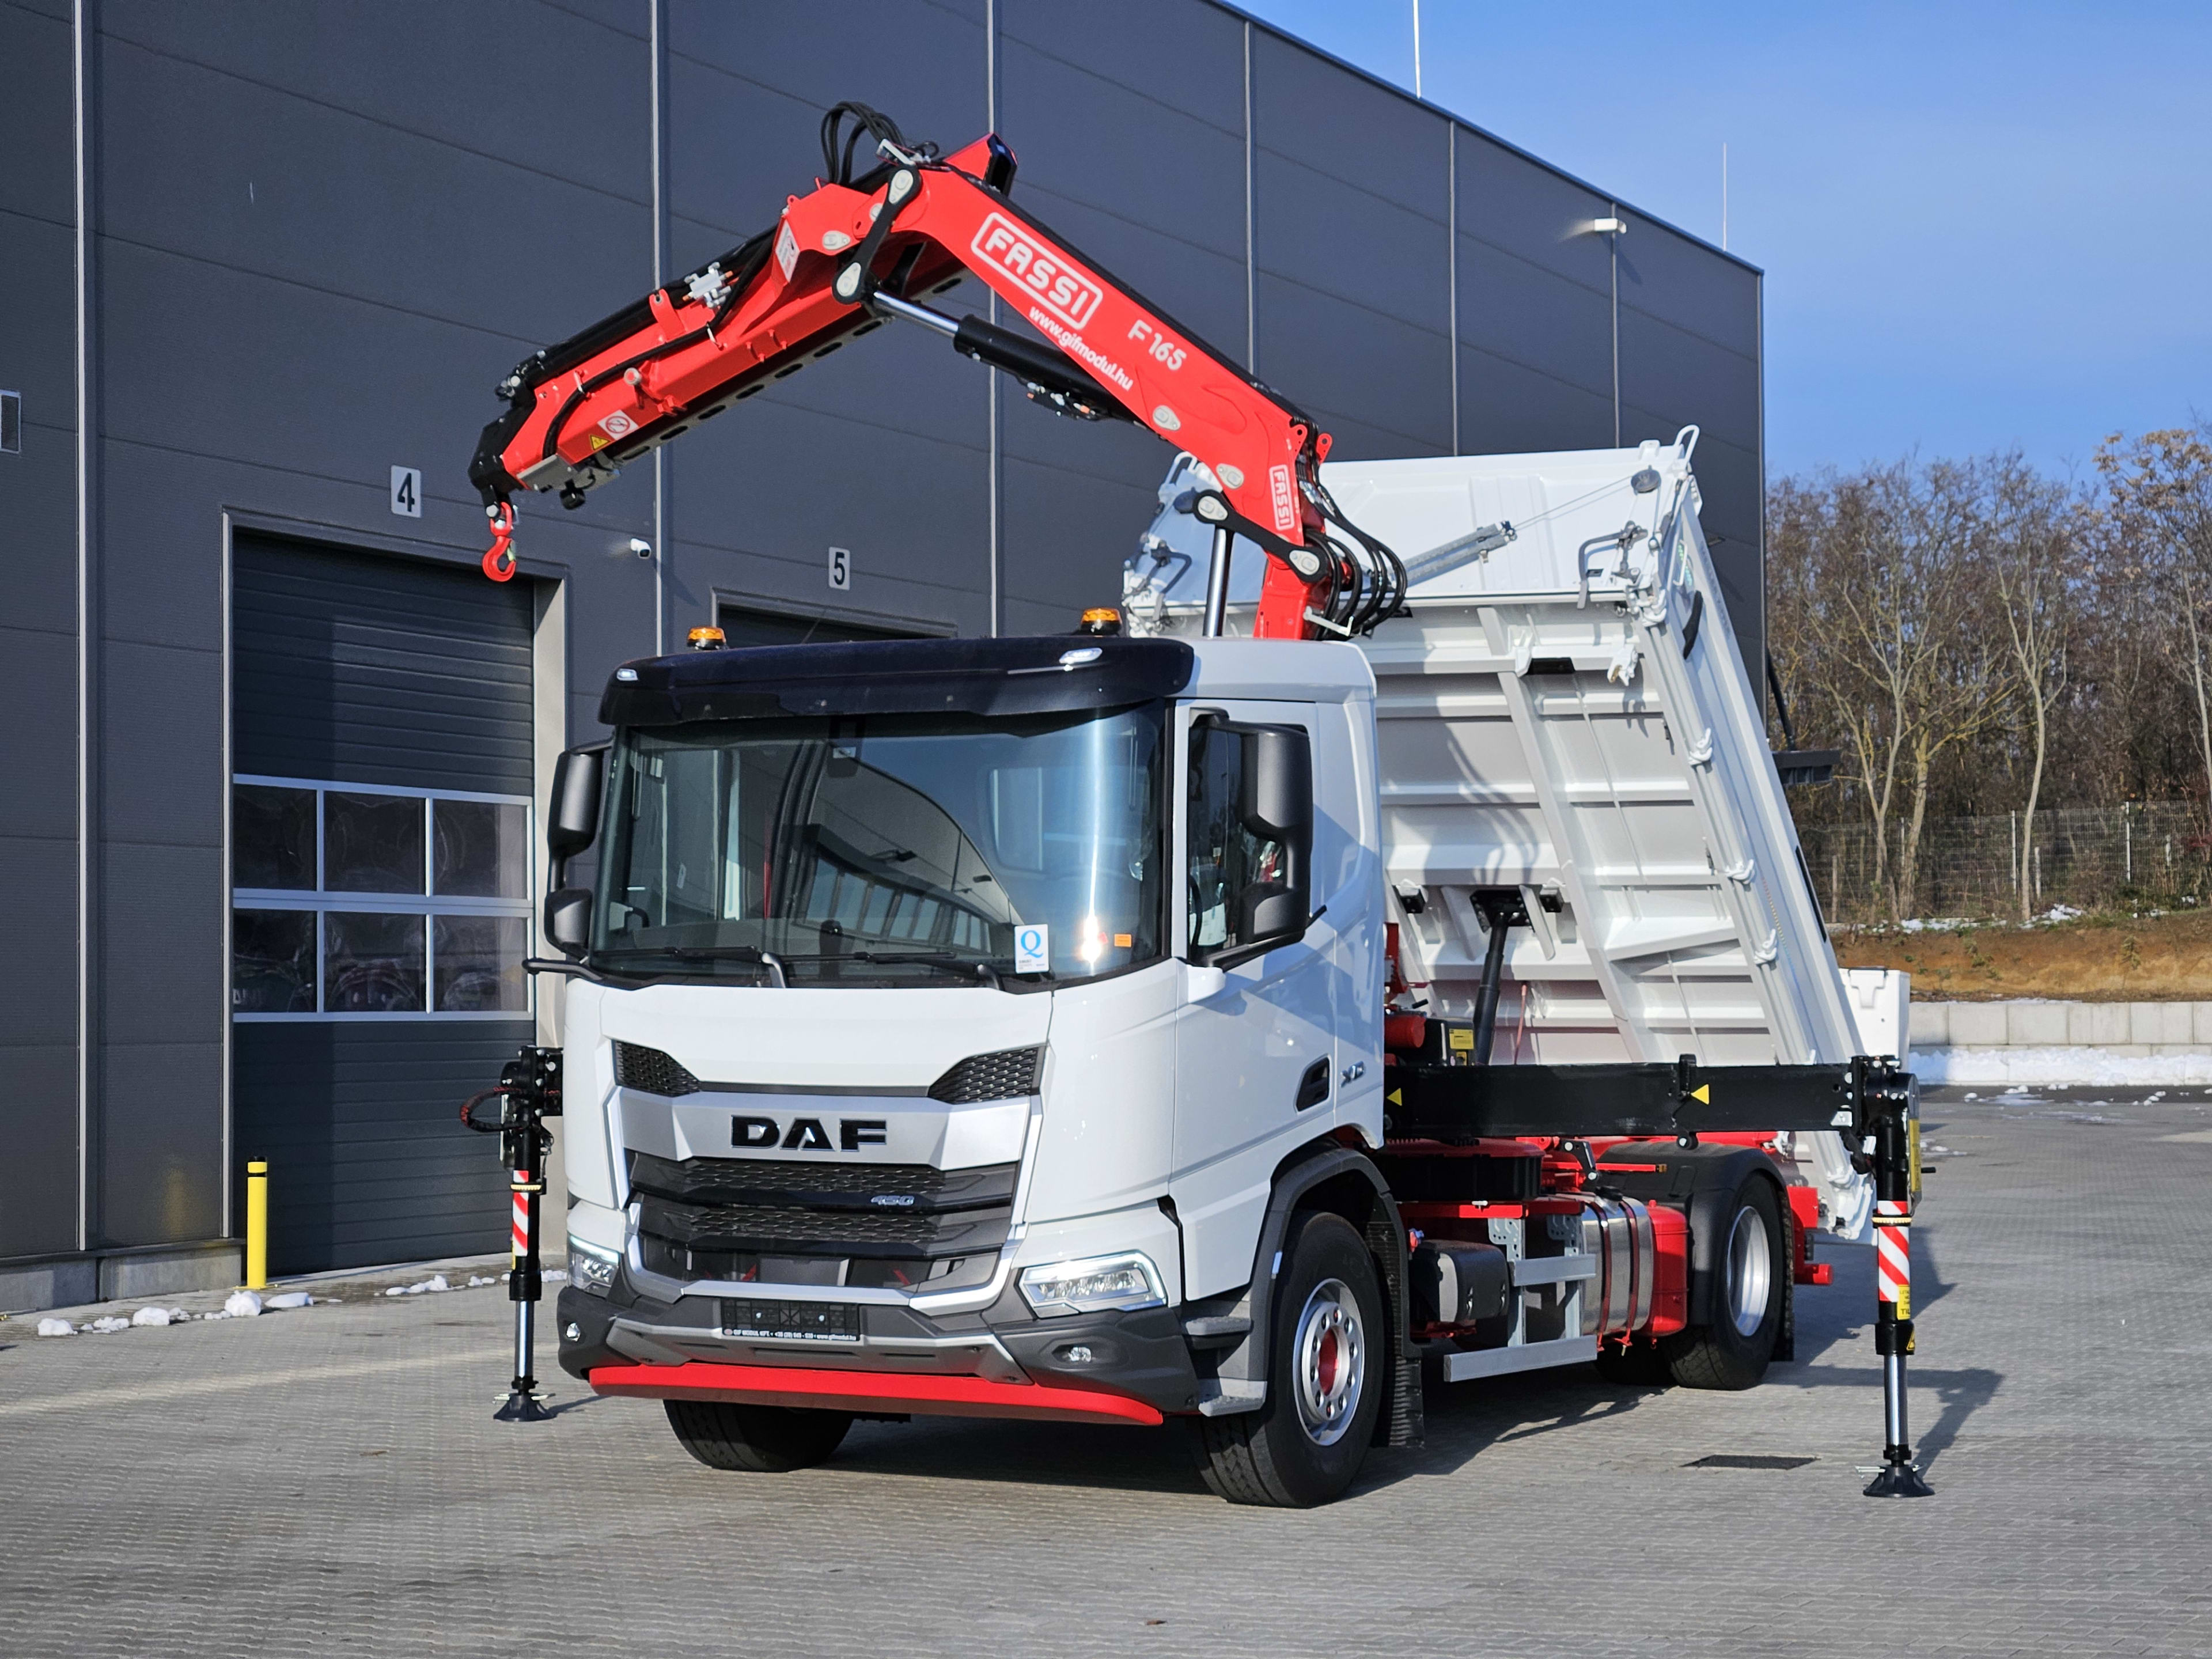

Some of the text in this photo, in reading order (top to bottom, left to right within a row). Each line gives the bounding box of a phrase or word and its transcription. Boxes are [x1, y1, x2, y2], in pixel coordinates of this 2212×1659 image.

[985, 228, 1088, 315] FASSI
[1029, 306, 1134, 392] www.gifmodul.hu
[1127, 319, 1187, 370] F 165
[397, 472, 415, 512] 4
[1273, 470, 1291, 525] FASSI
[834, 551, 846, 585] 5
[1021, 929, 1043, 959] Q
[730, 1114, 887, 1152] DAF
[870, 1195, 915, 1206] 450
